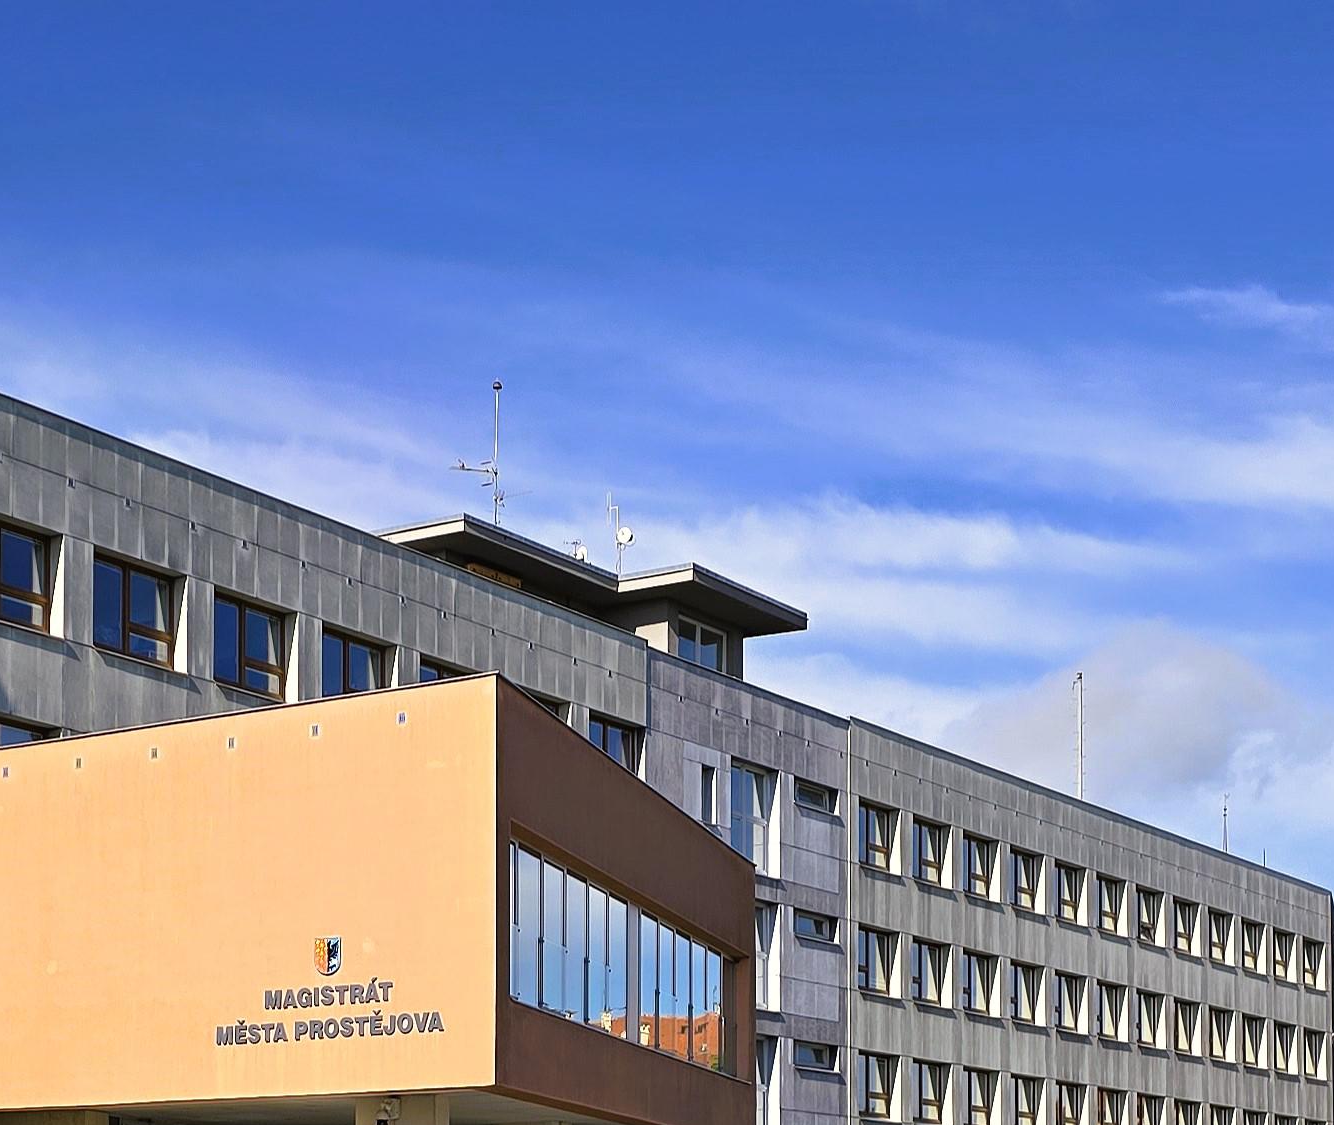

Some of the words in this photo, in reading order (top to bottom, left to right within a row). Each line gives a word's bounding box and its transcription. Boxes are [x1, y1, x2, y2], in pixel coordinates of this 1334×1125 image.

[265, 977, 393, 1010] MAGISTRÁT
[216, 1020, 288, 1045] MĚSTA
[294, 1009, 444, 1042] PROSTĚJOVA
